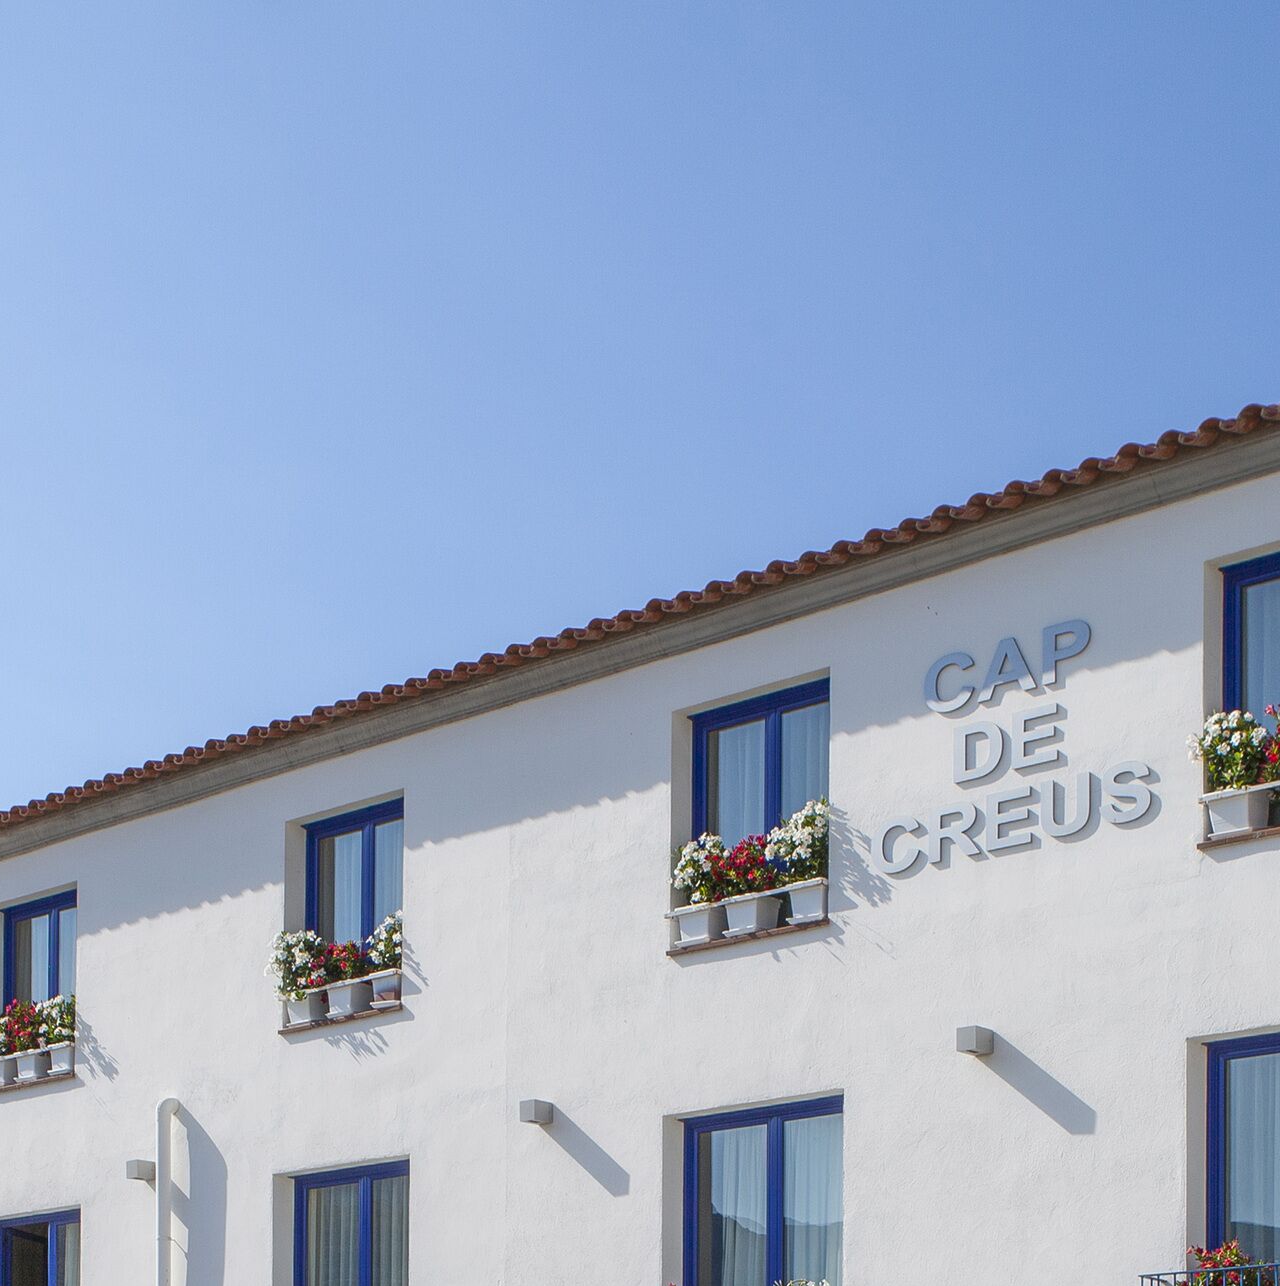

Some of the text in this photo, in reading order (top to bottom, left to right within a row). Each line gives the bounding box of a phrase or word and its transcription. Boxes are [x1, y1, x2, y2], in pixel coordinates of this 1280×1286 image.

[923, 619, 1092, 714] CAP
[952, 703, 1061, 784] DE
[871, 761, 1152, 875] CREUS
